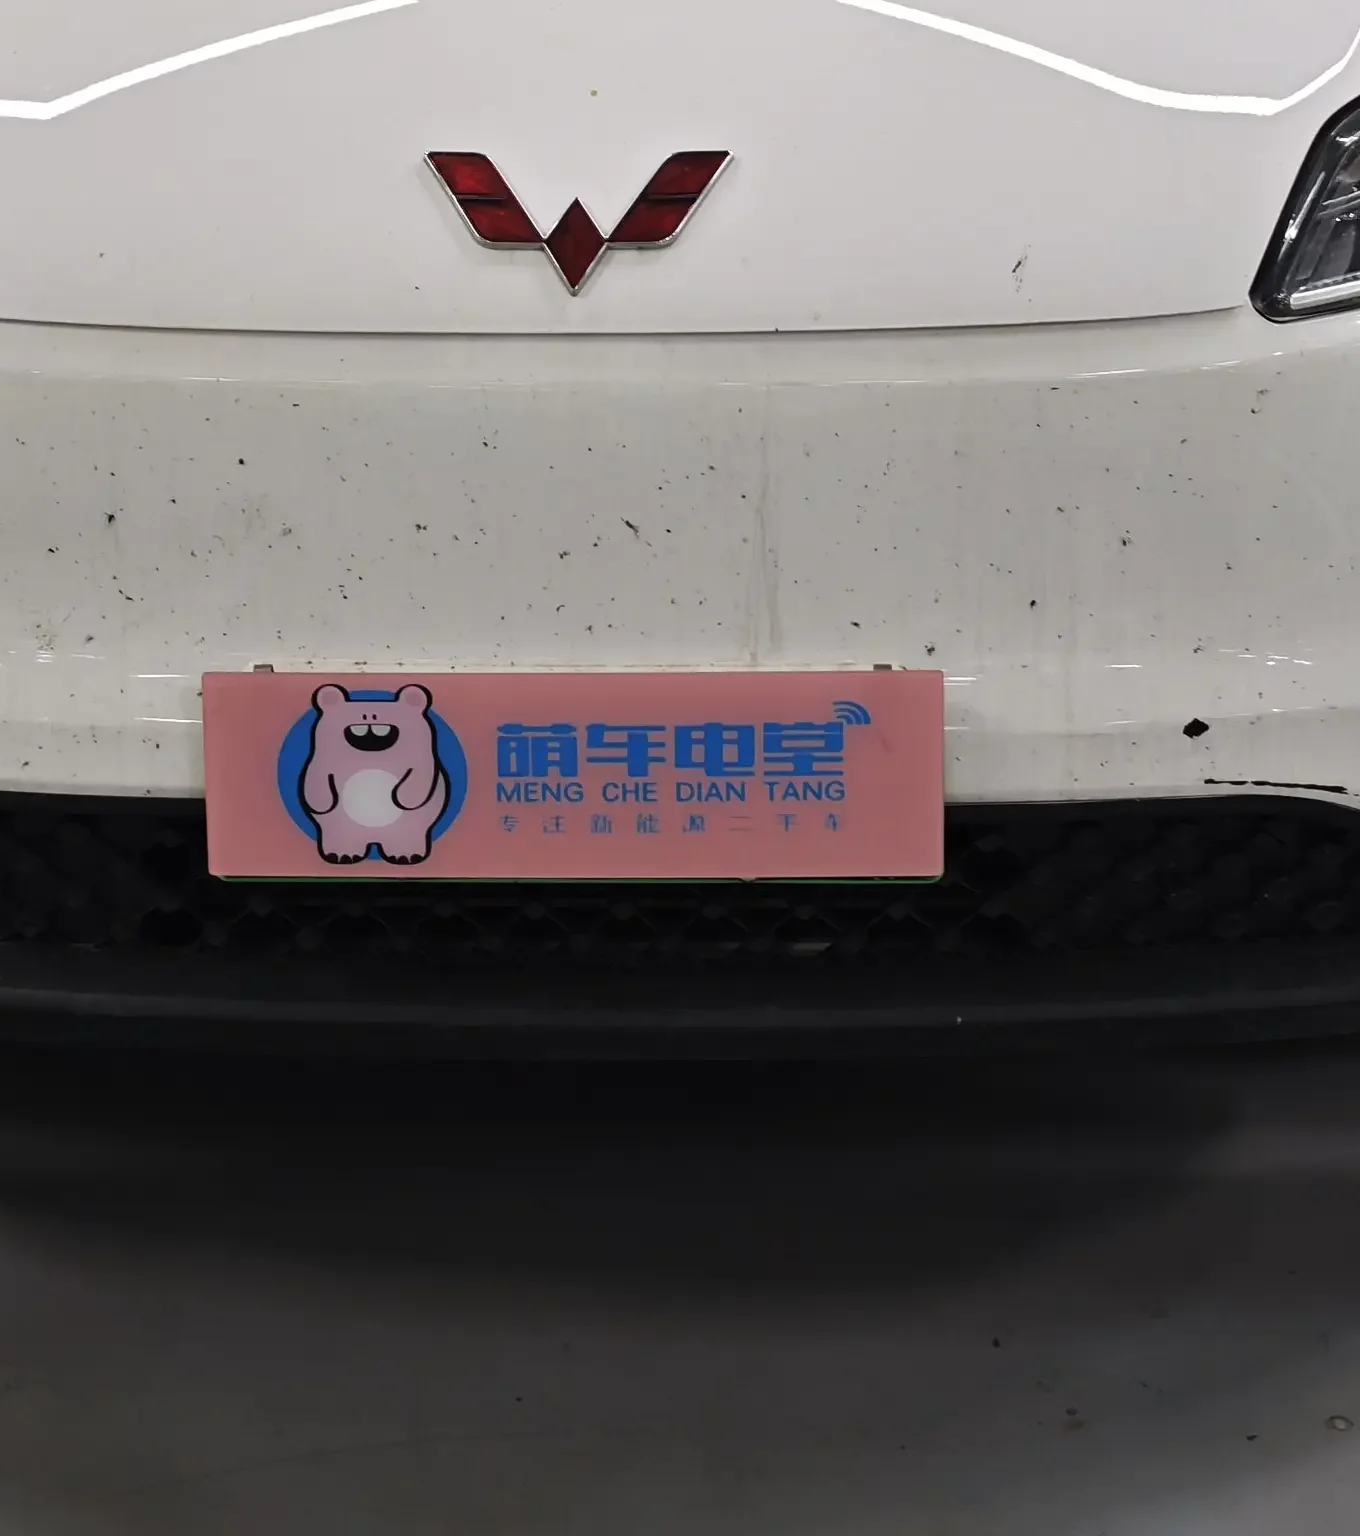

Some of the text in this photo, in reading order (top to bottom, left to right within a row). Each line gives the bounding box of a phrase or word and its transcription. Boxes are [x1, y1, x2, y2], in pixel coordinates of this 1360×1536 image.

[496, 721, 845, 779] 萌车电堂
[496, 780, 846, 804] MENG CHE DIAN TANG
